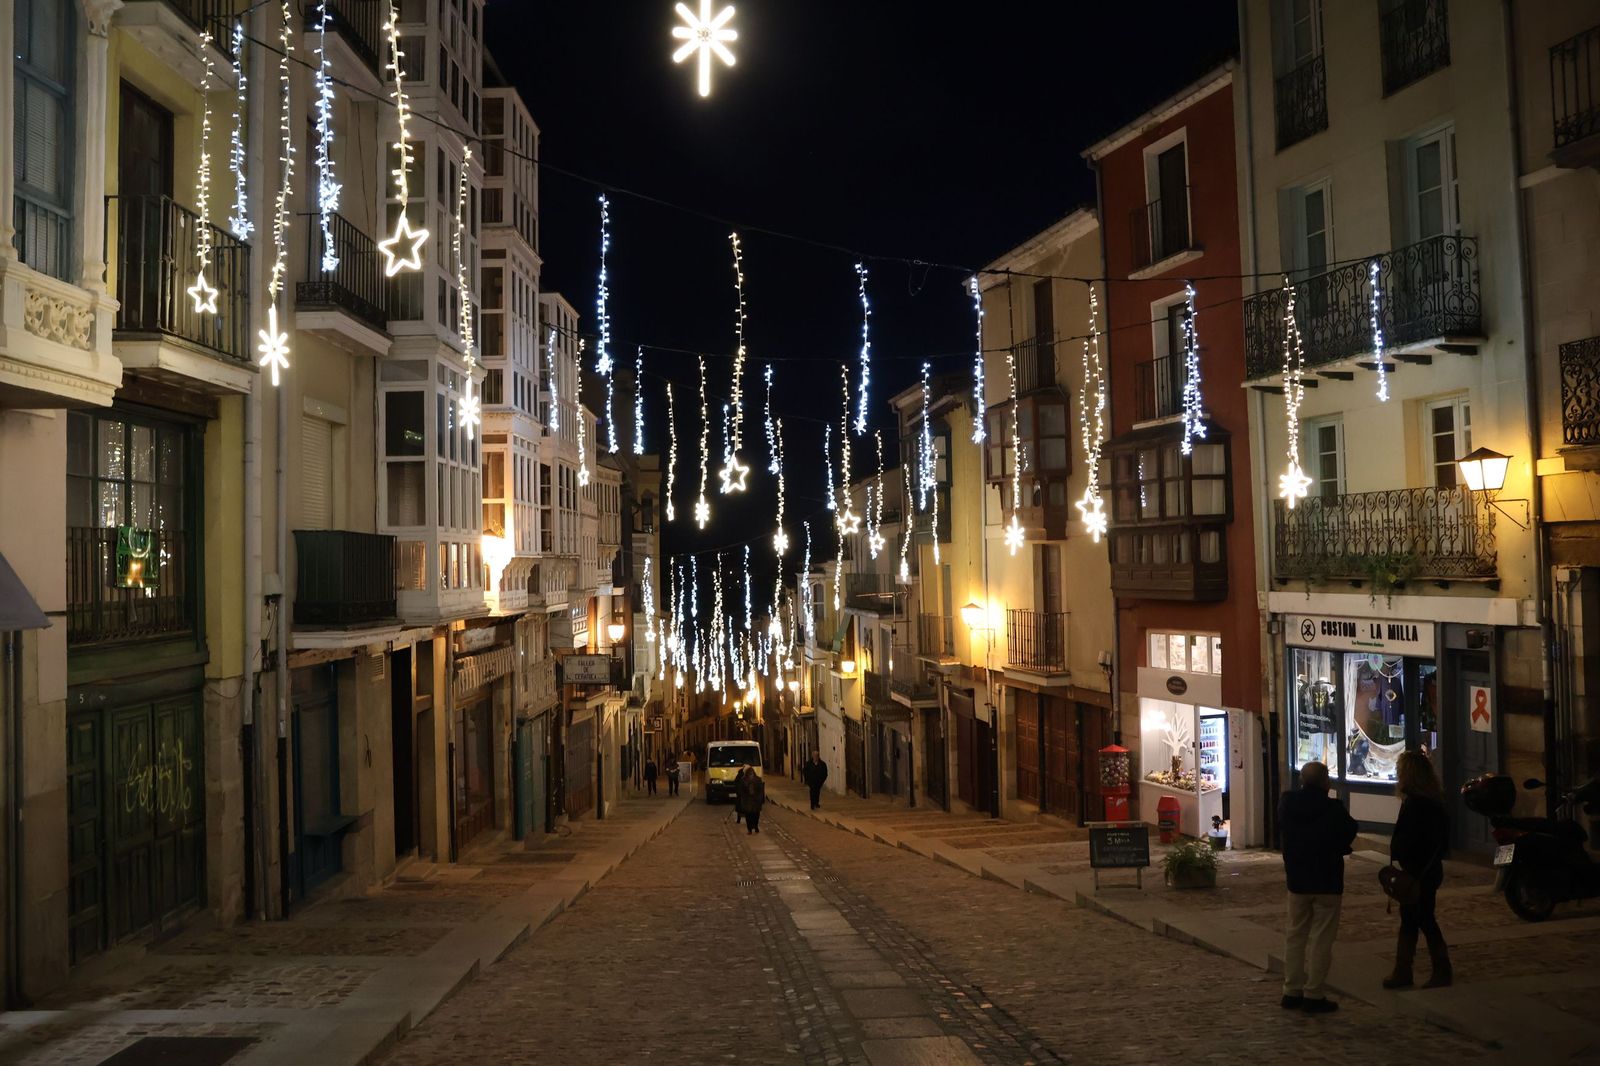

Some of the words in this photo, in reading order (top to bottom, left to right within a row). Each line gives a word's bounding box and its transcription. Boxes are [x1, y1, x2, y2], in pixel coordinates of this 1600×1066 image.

[1321, 620, 1357, 638] CUSTOM
[1370, 623, 1382, 640] LA
[1387, 624, 1418, 642] MILLA
